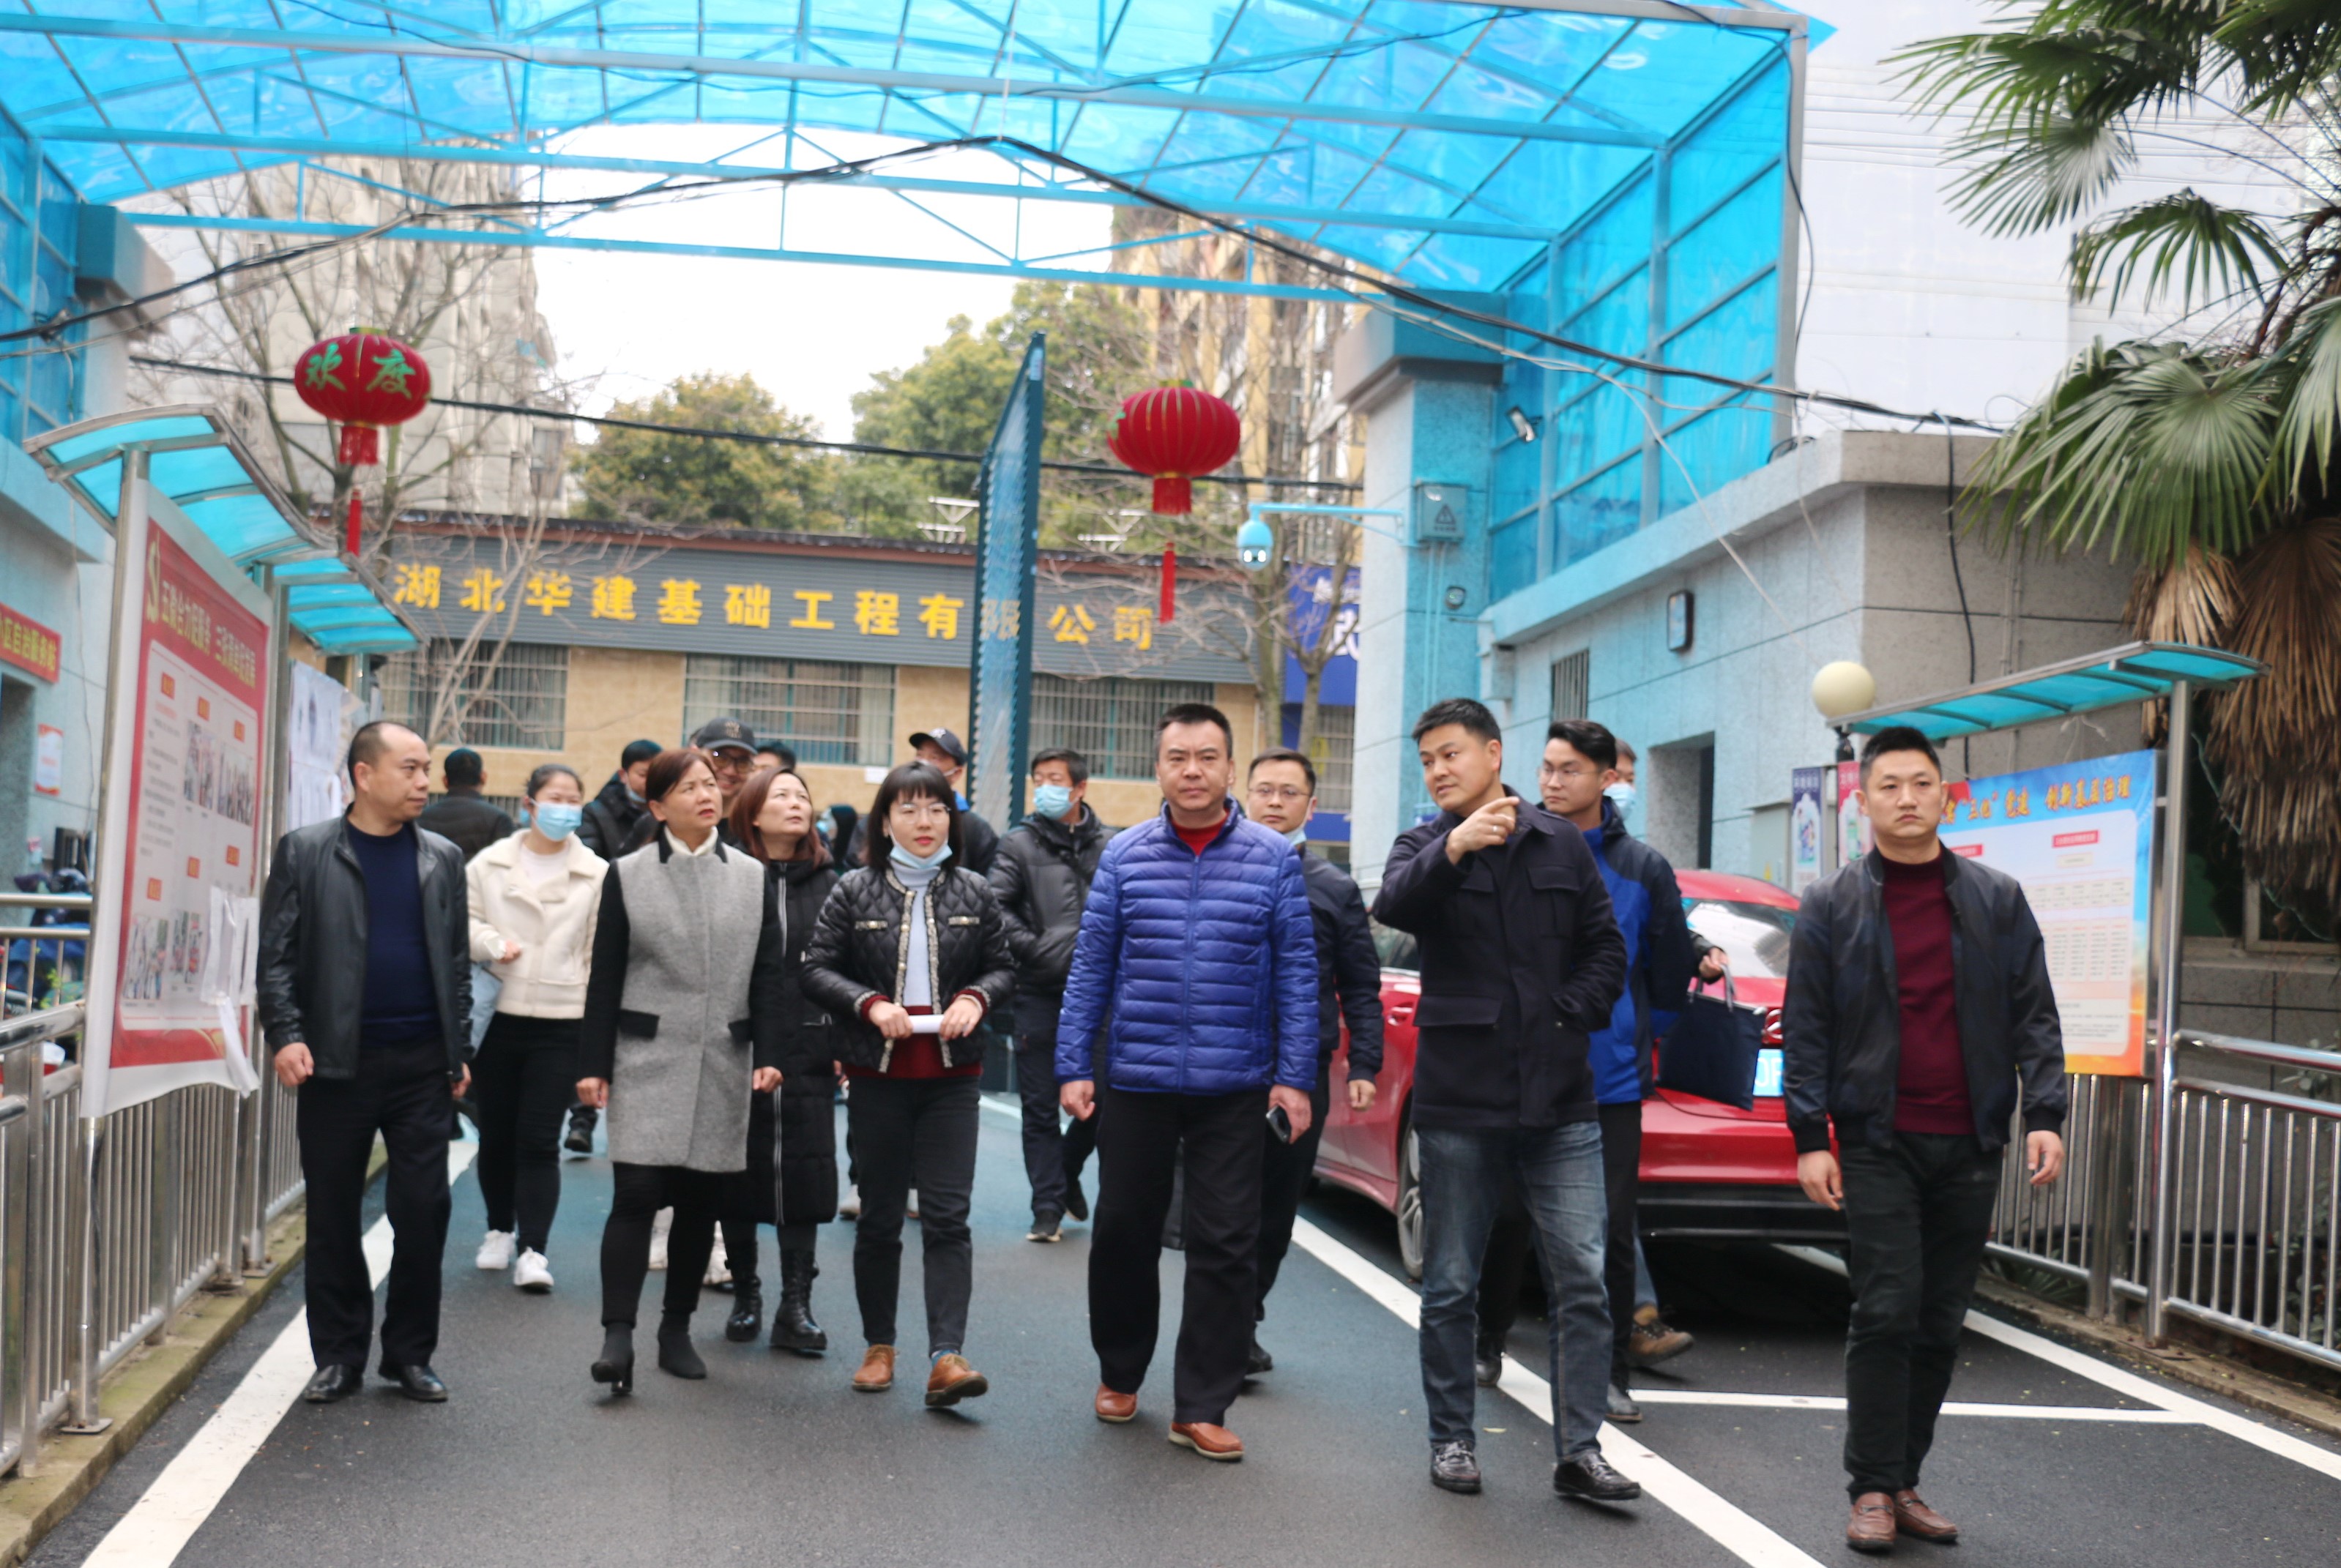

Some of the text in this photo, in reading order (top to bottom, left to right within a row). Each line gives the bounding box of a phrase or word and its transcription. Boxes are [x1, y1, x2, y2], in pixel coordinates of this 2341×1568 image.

[305, 343, 416, 399] 欢度
[394, 563, 1153, 650] 湖北华建基础工程有限公司
